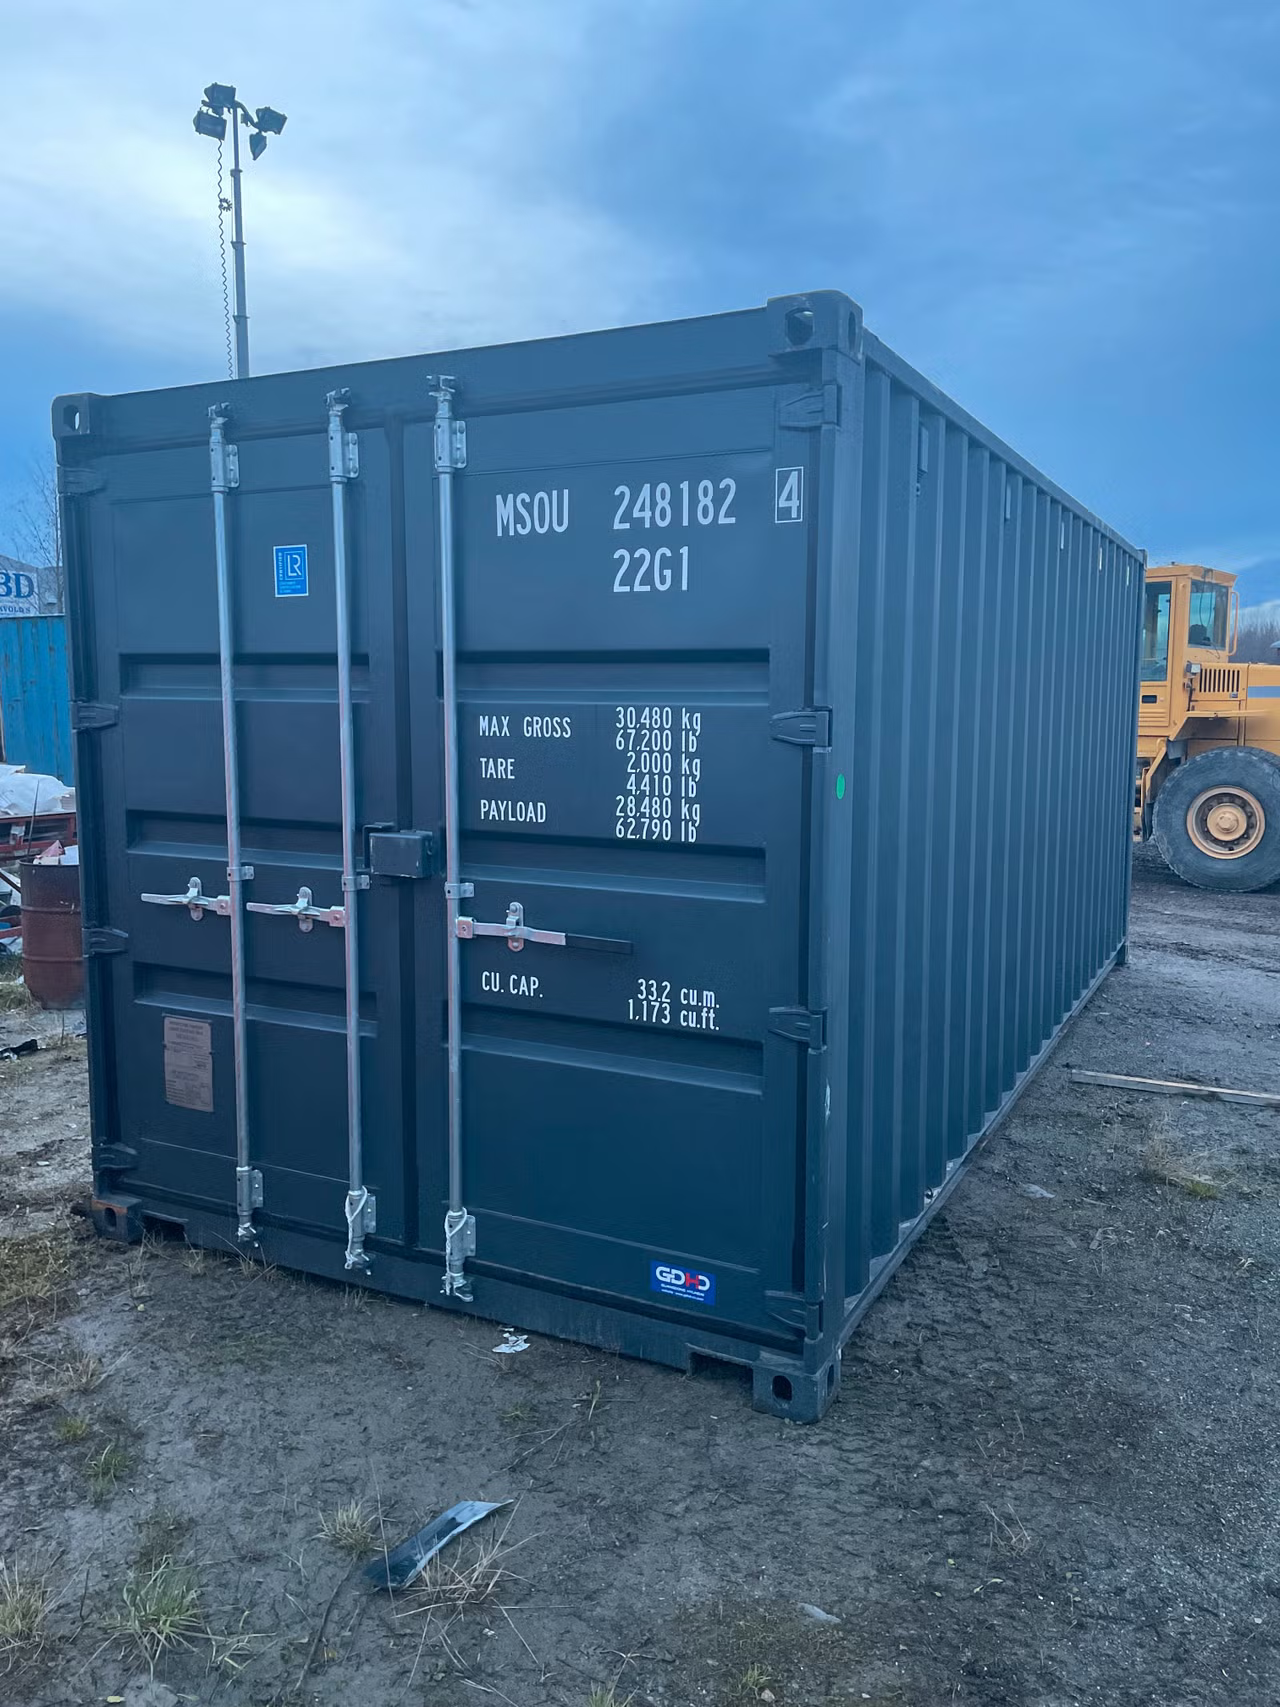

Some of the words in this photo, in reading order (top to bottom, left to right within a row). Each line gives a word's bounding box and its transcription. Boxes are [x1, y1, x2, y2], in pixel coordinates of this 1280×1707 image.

[496, 489, 568, 536] MSOU
[613, 478, 736, 529] 248182
[778, 470, 800, 519] 4
[287, 554, 302, 576] LR
[614, 546, 688, 592] 22G1
[479, 715, 510, 737] MAX
[523, 716, 572, 738] GROSS
[615, 706, 672, 730] 30,480
[681, 707, 701, 736] kg
[615, 729, 672, 752] 67,200
[681, 731, 698, 753] lb
[480, 758, 515, 779] TARE
[626, 752, 672, 774] 2,000
[681, 753, 701, 782] kg
[626, 774, 672, 796] 4,410
[681, 776, 698, 798] lb
[480, 799, 546, 823] PAYLOAD
[615, 795, 672, 818] 28,480
[681, 799, 701, 827] kg
[615, 817, 672, 841] 62,790
[681, 821, 698, 843] lb
[482, 971, 505, 993] CU.
[510, 974, 543, 998] CAP.
[636, 978, 671, 1003] 33.2
[680, 987, 720, 1009] cu.m.
[628, 998, 671, 1024] 1,173
[680, 1008, 720, 1031] cu.ft.
